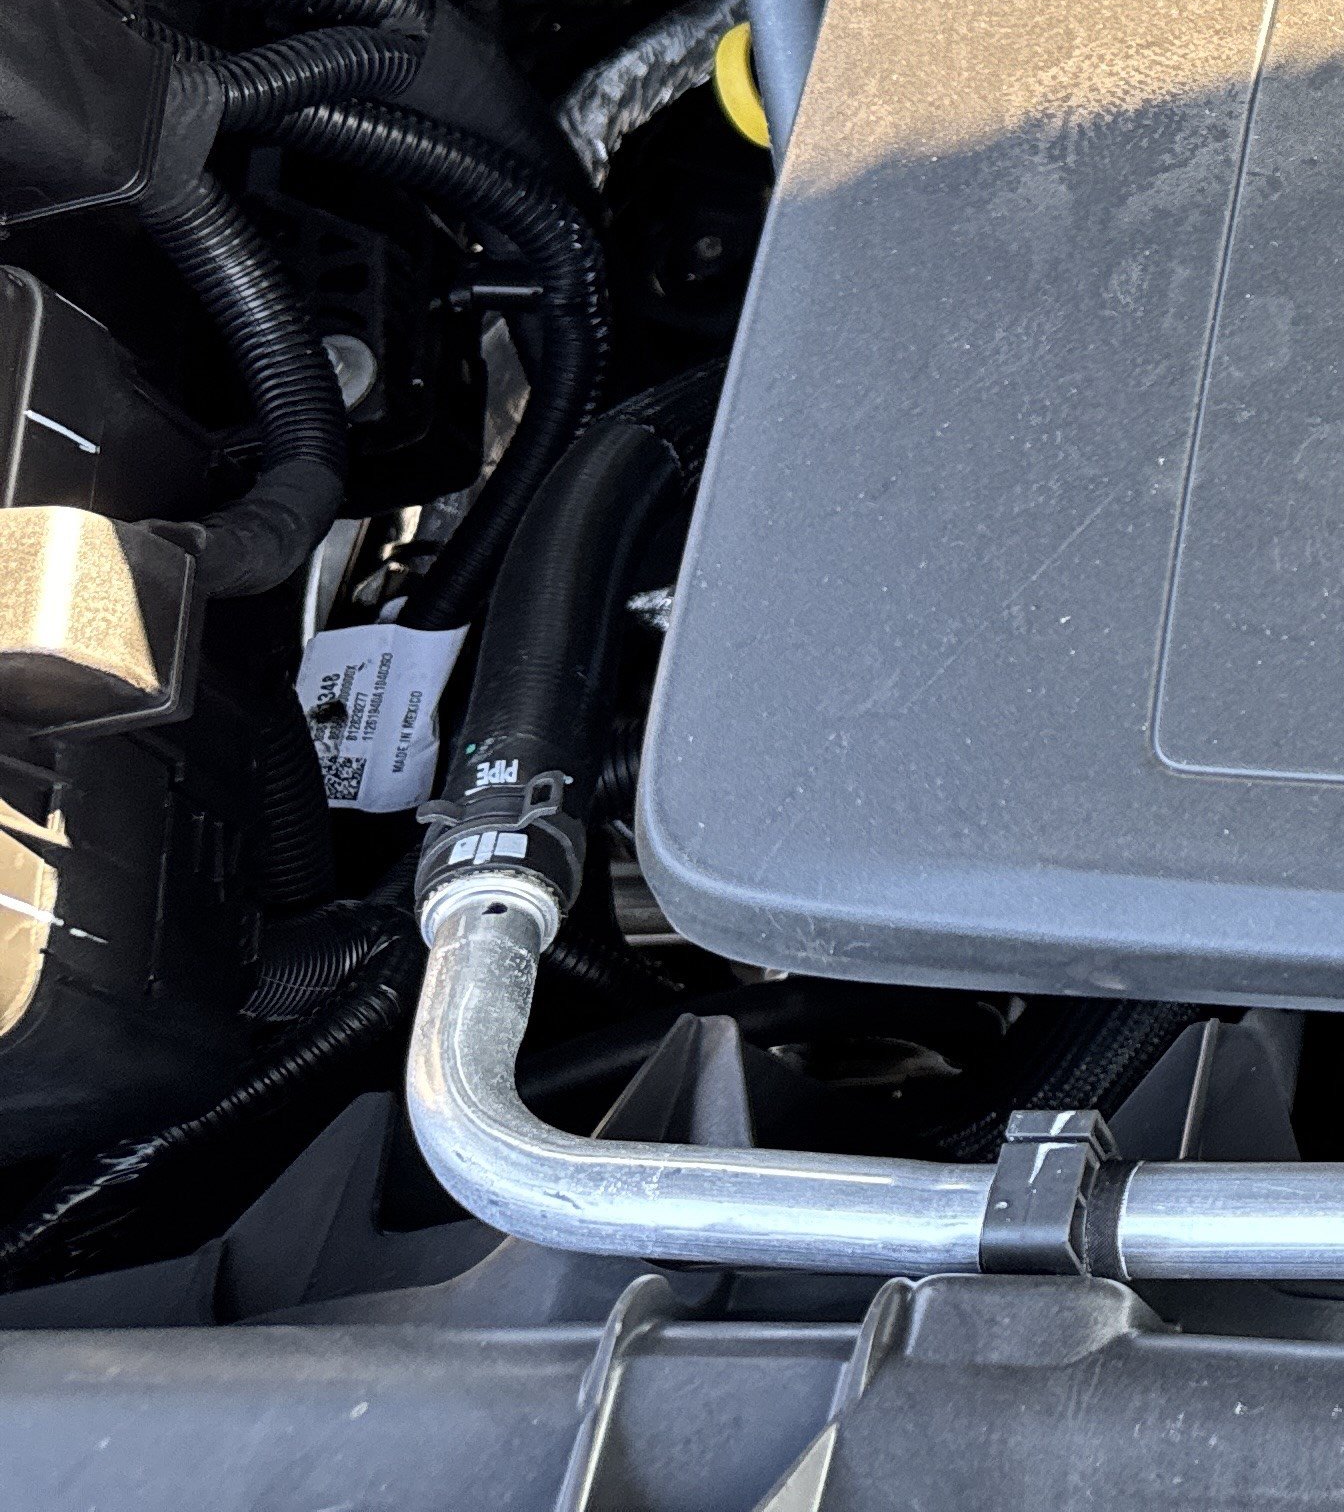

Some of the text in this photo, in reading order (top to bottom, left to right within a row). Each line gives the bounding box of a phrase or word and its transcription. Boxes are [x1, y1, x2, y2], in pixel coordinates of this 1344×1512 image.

[391, 690, 423, 773] MADE IN MEXICO
[476, 758, 519, 786] PIPE
